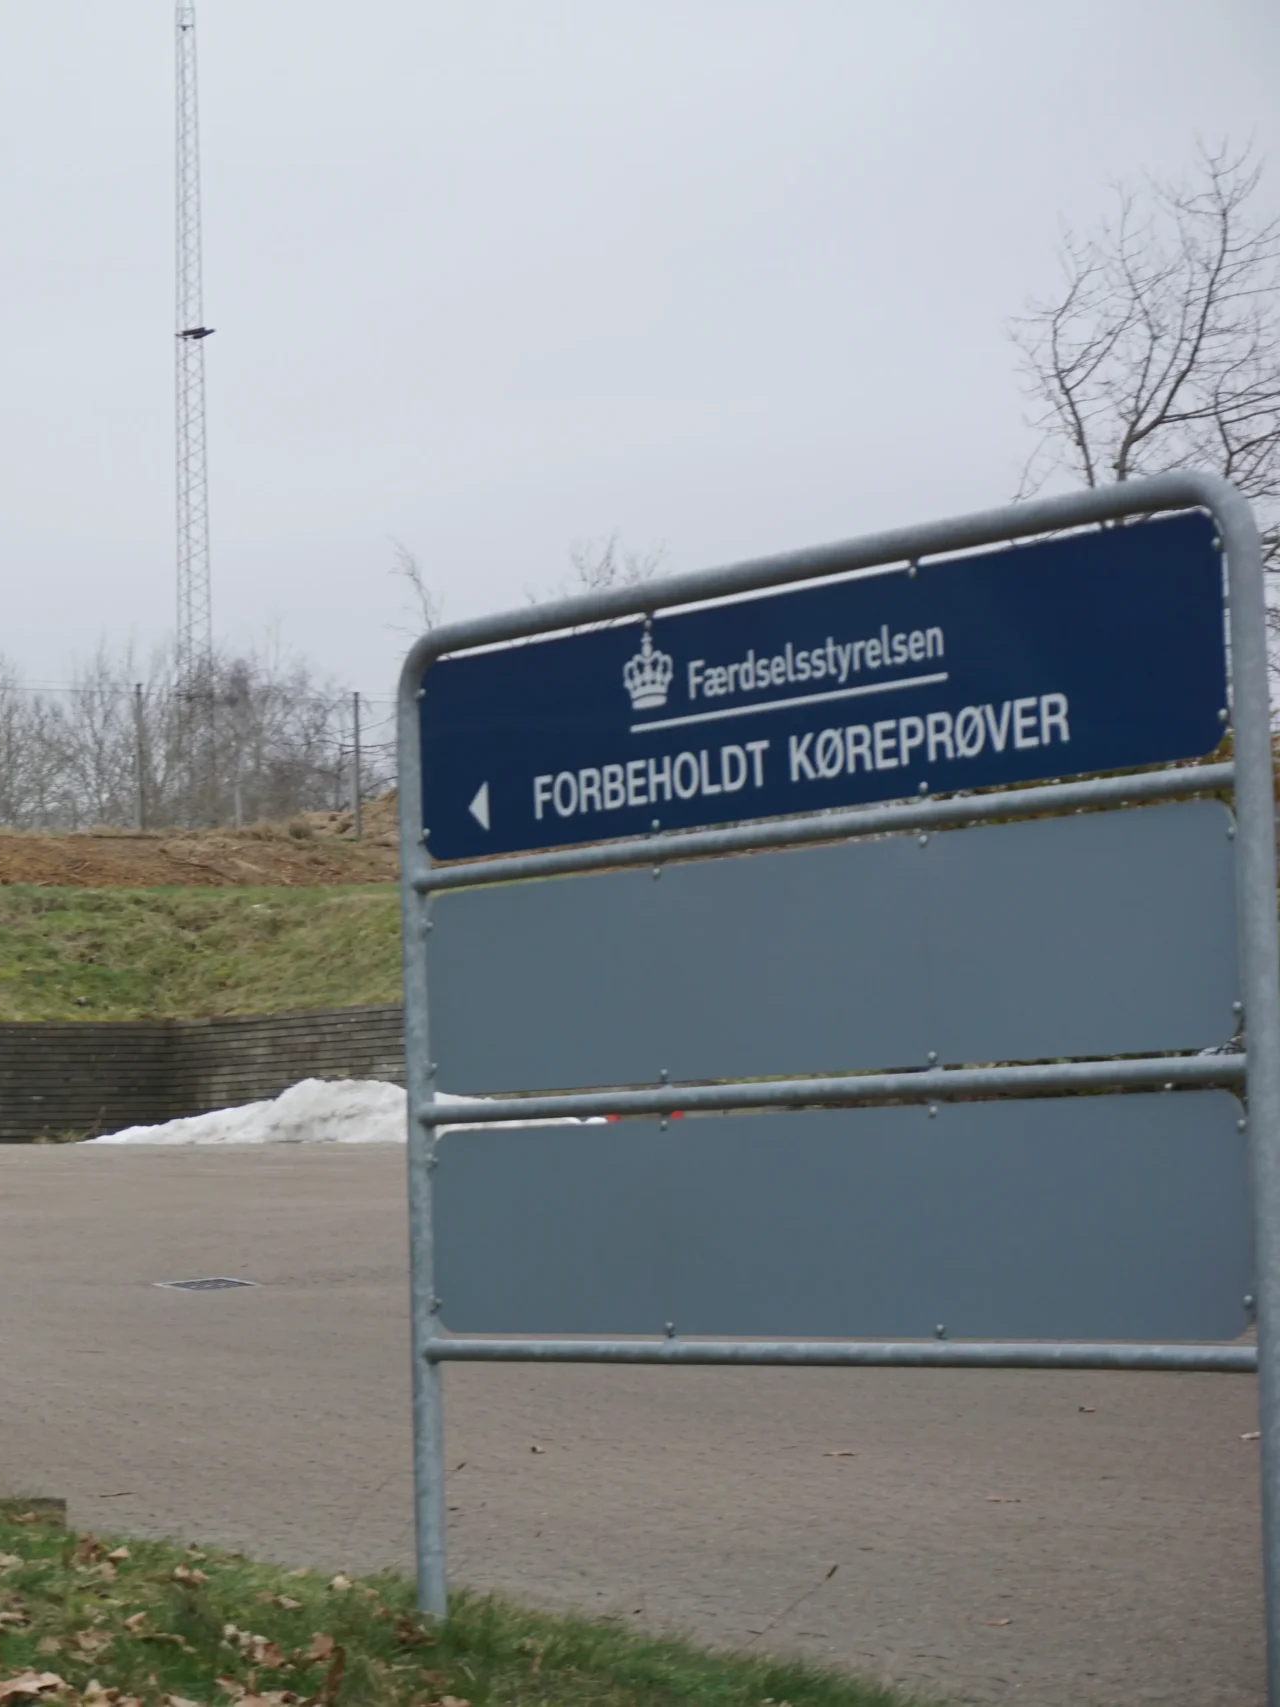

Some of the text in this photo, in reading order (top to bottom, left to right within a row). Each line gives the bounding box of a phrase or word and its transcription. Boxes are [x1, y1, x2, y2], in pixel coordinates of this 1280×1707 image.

[688, 624, 944, 700] Færdselsstyrelsen
[533, 692, 1070, 820] FORBEHOLDT KØREPRØVER
